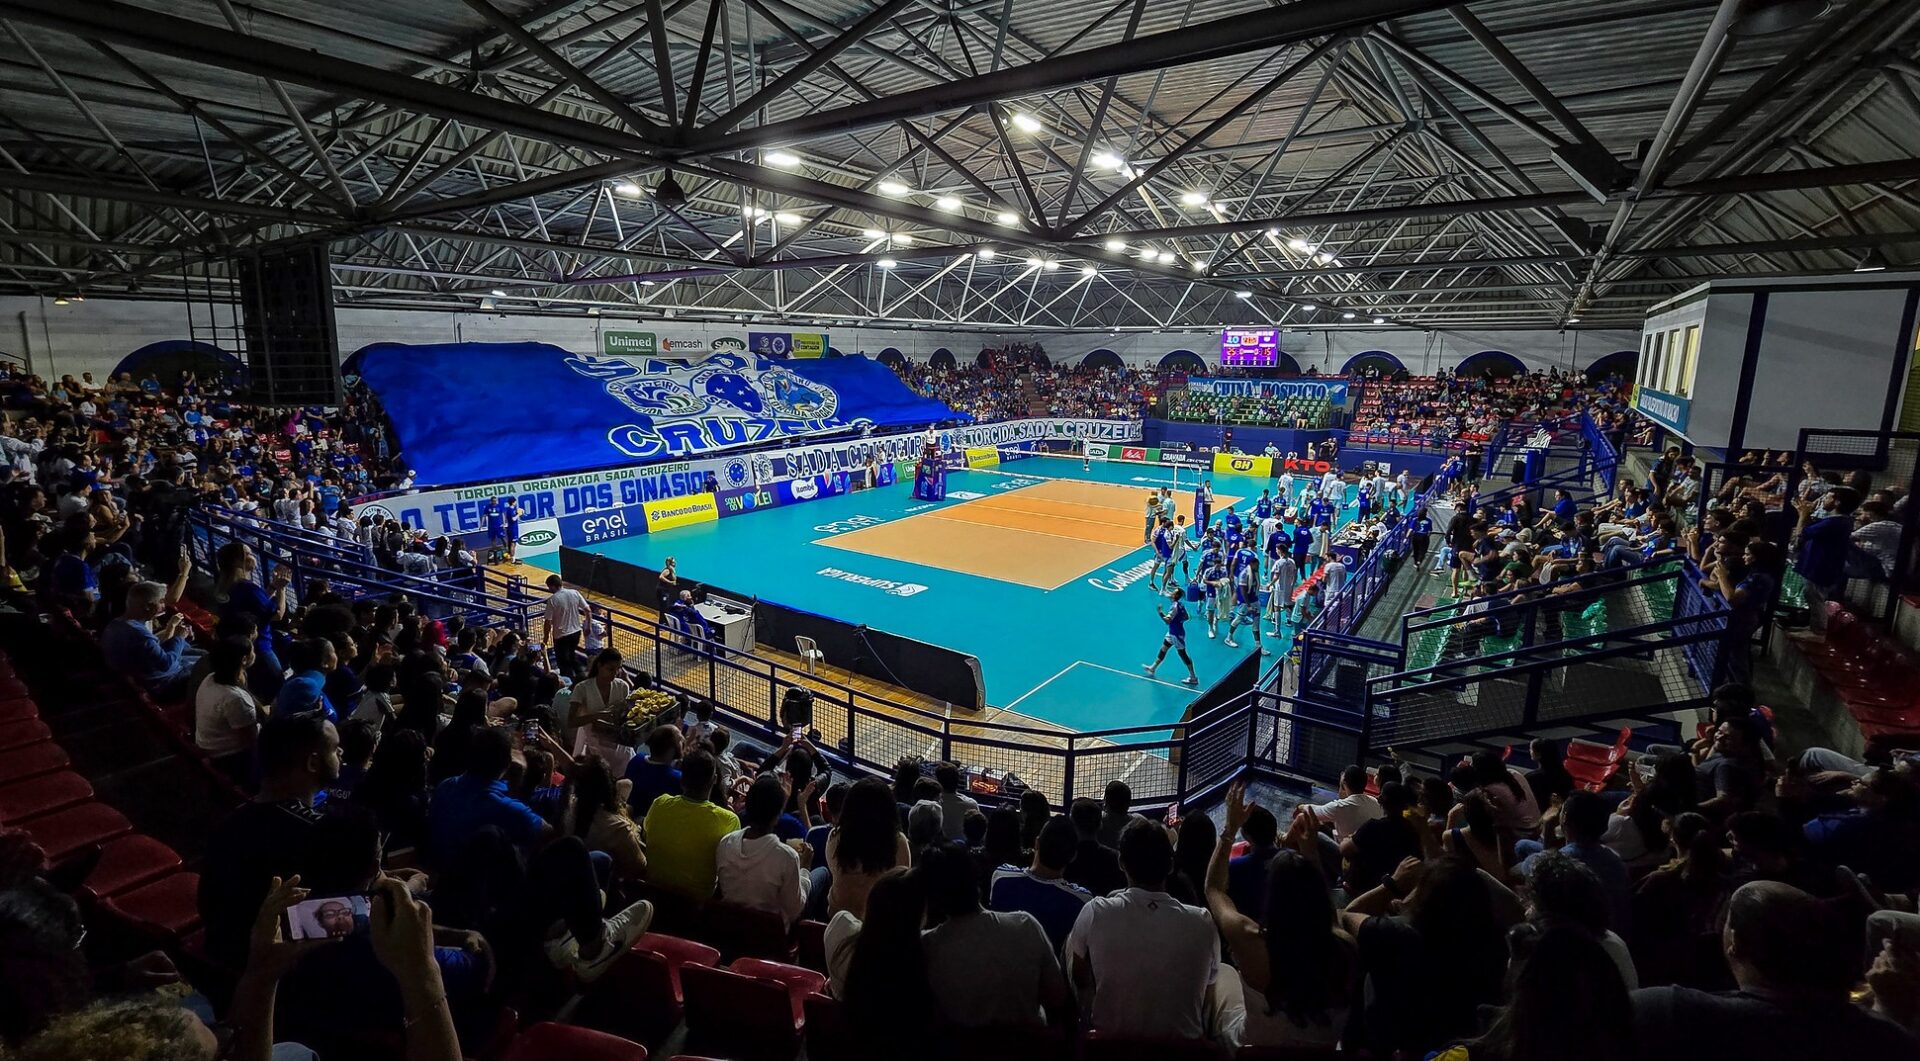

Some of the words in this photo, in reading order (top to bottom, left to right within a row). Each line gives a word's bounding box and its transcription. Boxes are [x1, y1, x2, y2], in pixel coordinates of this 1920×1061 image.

[609, 336, 652, 347] Unimed
[965, 424, 1015, 447] TORCIDA
[1018, 420, 1057, 439] SADA
[785, 447, 842, 478] SADA
[1234, 460, 1250, 470] BH
[1284, 459, 1331, 473] KTO
[454, 484, 517, 501] TORCIDA
[522, 473, 600, 492] ORGANIZADA
[605, 469, 635, 482] SADA
[640, 462, 690, 477] CRUZEIRO
[562, 482, 614, 515] DOS
[582, 509, 628, 534] enel
[520, 532, 552, 545] SADA
[585, 528, 628, 543] BRASIL
